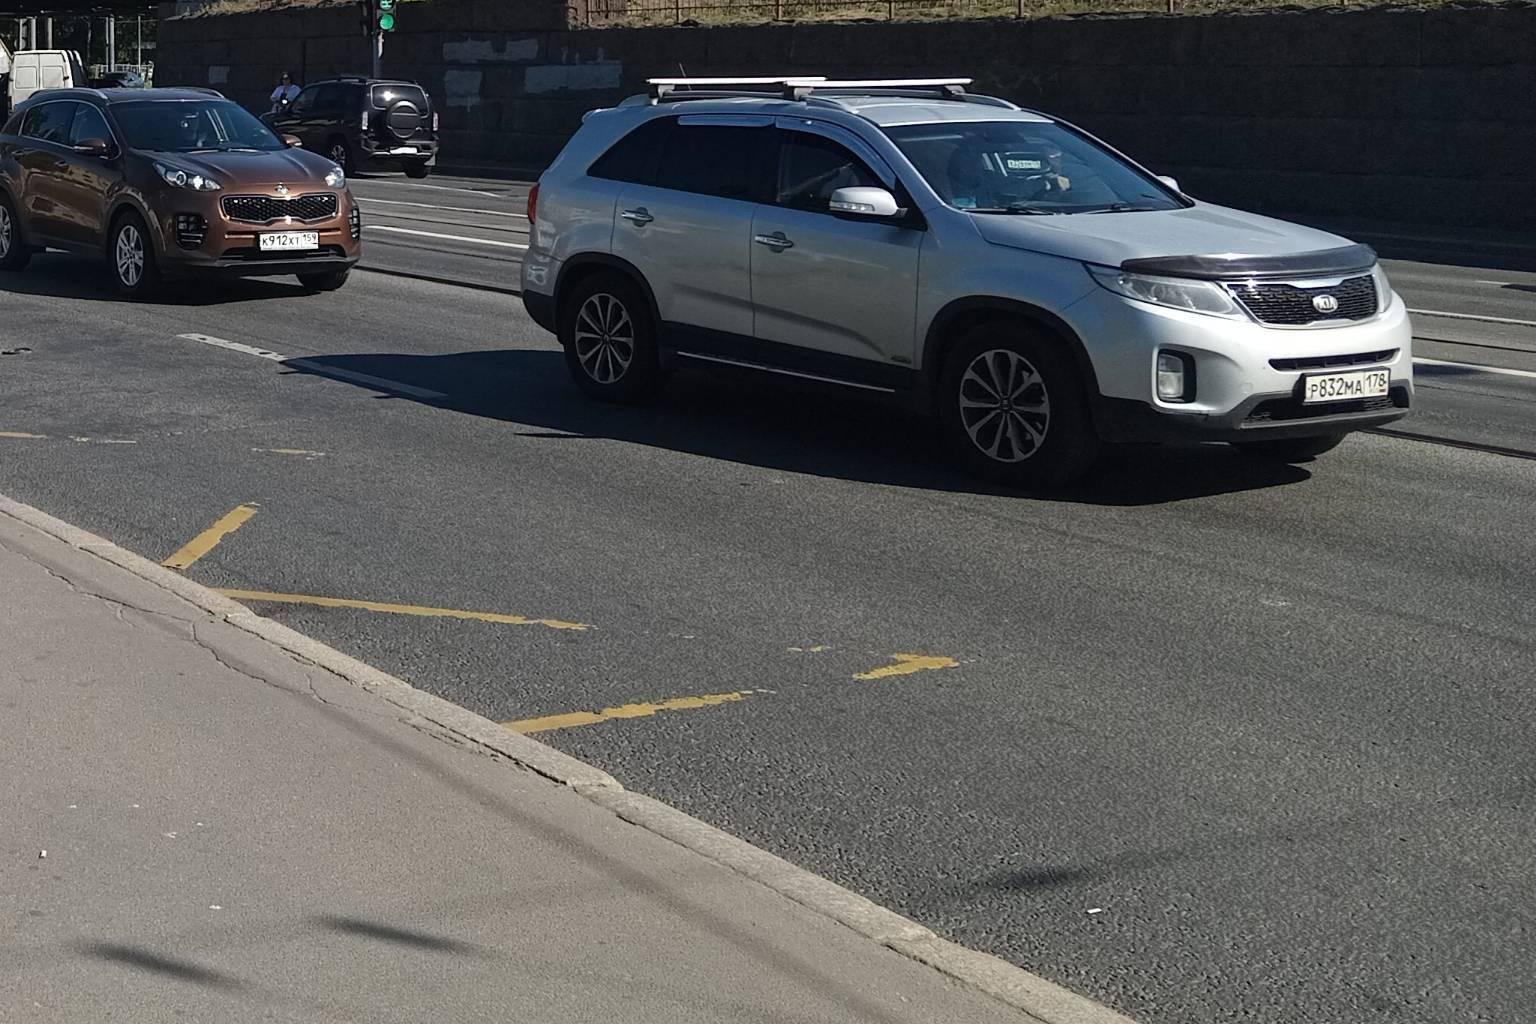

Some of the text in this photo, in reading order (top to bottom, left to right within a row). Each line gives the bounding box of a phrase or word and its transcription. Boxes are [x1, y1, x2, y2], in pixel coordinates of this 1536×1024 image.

[262, 234, 317, 246] К912ХТ 159
[1310, 373, 1385, 398] Р832МА 178
